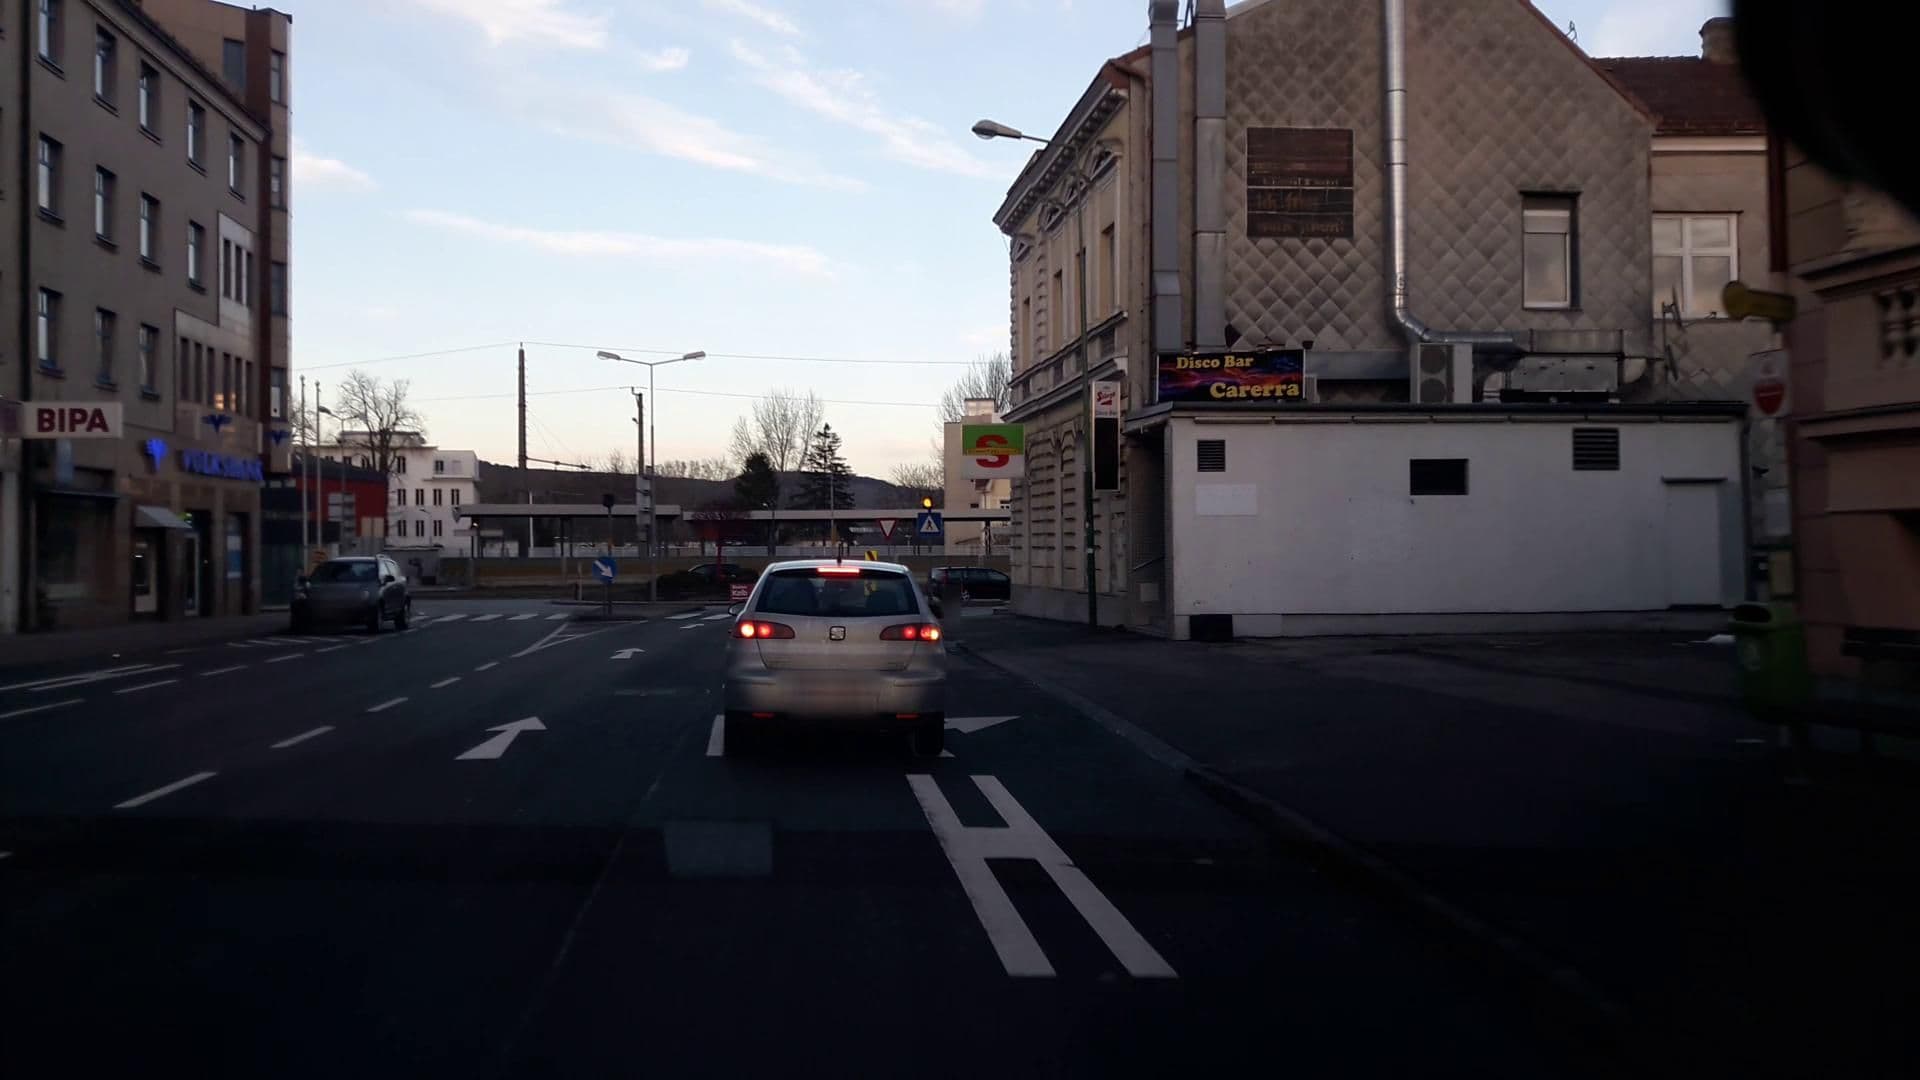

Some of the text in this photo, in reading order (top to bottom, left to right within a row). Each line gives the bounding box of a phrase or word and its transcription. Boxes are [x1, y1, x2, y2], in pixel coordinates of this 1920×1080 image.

[1175, 354, 1256, 369] Disco Bar
[1209, 381, 1301, 399] Carerra
[37, 408, 109, 432] BIPA
